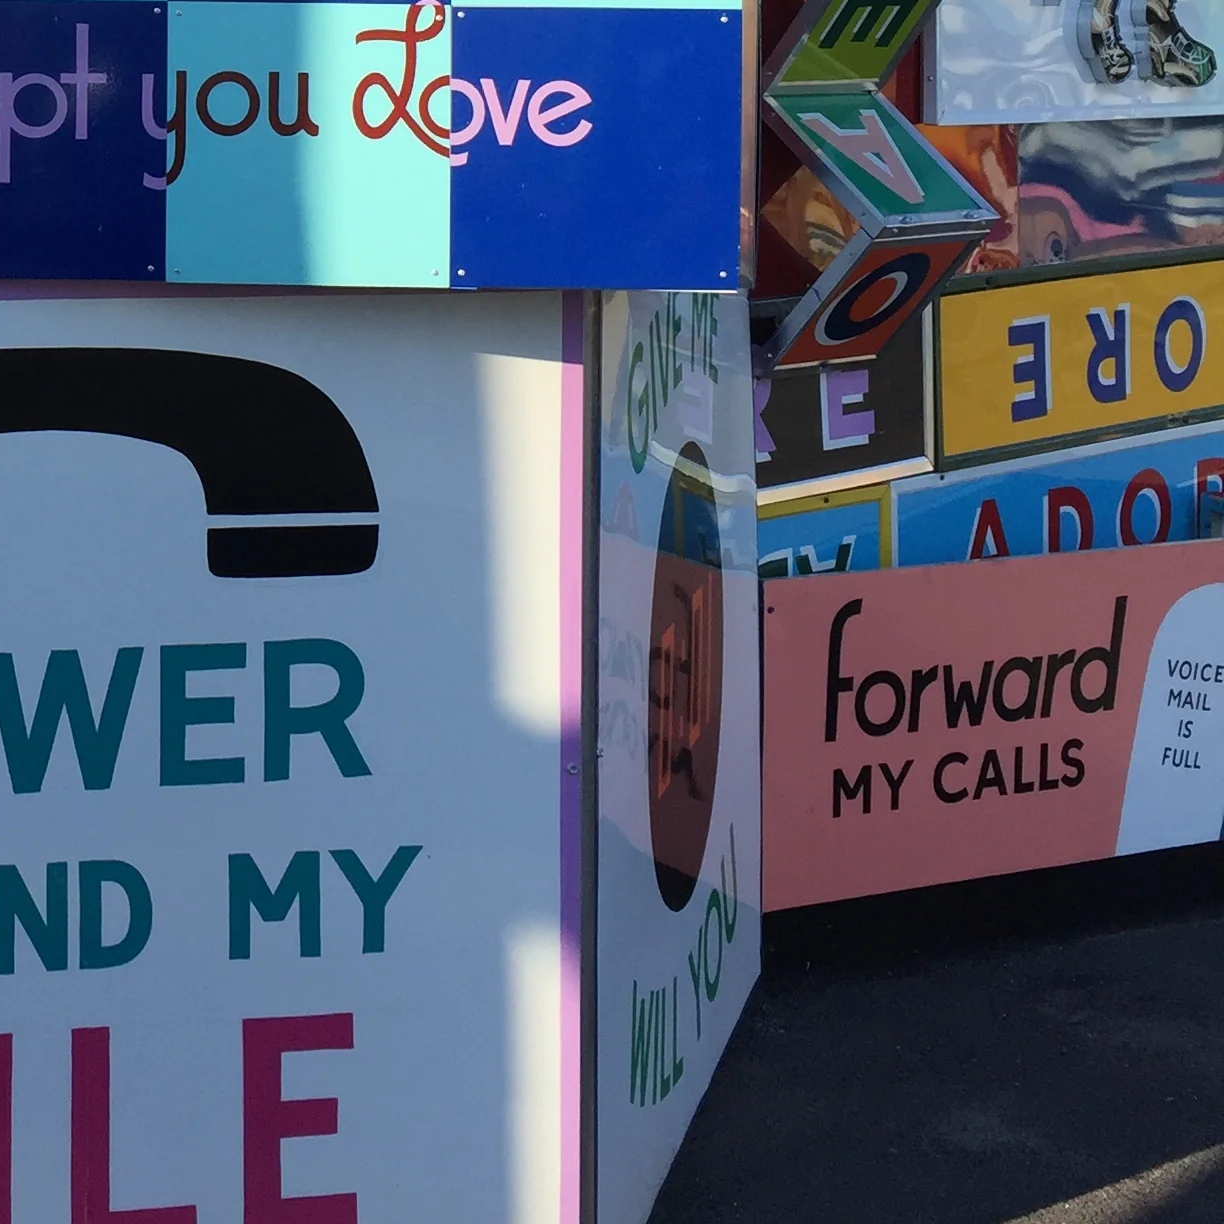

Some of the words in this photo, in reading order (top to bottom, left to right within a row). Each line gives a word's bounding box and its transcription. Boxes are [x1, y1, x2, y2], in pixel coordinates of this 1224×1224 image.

[139, 70, 320, 190] you
[824, 596, 1128, 743] forward
[1167, 658, 1224, 684] VOICE
[1167, 688, 1212, 712] MAIL
[1161, 747, 1202, 770] FULL
[1177, 719, 1194, 739] IS
[832, 759, 914, 819] MY
[933, 738, 1086, 804] CALLS
[228, 845, 424, 960] MY
[629, 975, 685, 1108] WILL
[687, 822, 738, 1042] YOU
